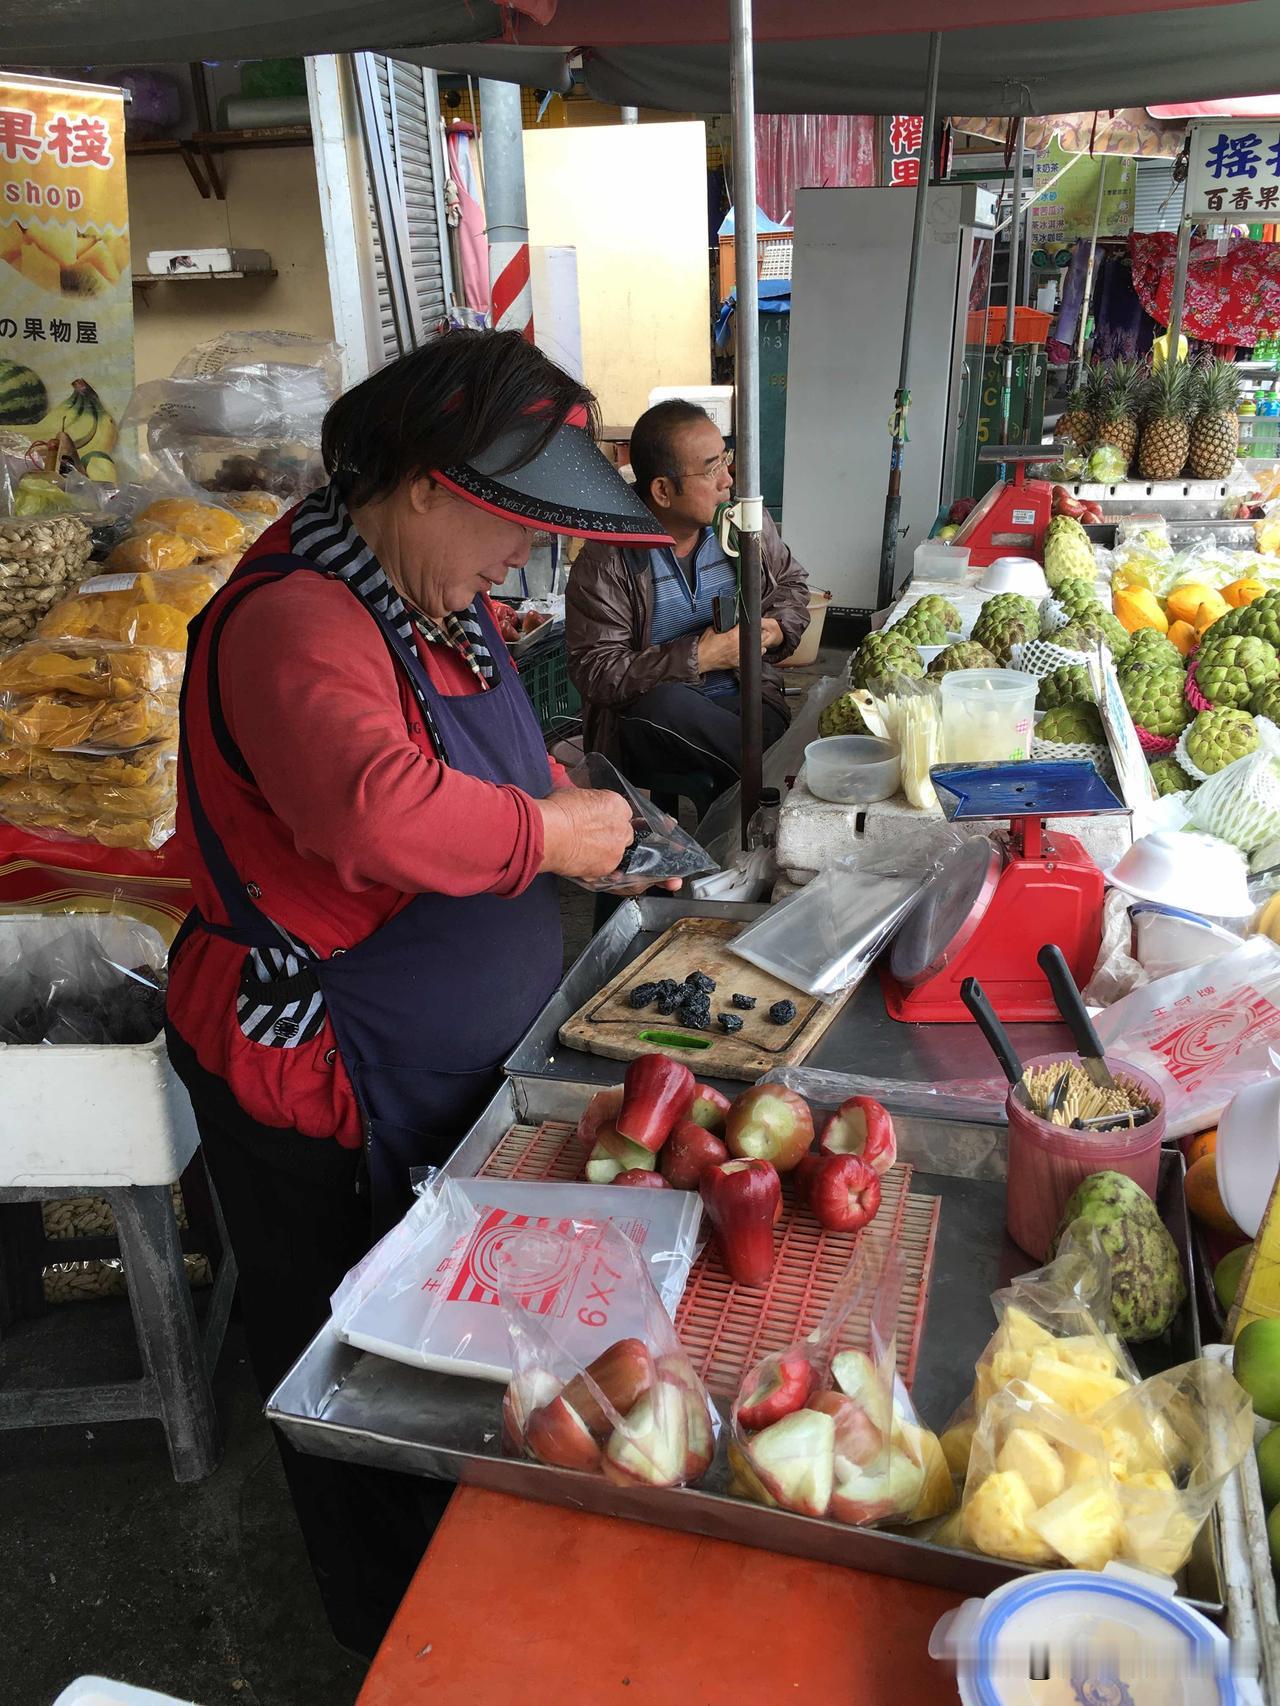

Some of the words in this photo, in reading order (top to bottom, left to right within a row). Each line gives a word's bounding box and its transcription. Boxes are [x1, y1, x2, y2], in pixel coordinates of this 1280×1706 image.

[6, 181, 81, 209] shop
[1204, 186, 1279, 211] 百香果
[0, 318, 98, 344] の果物屋
